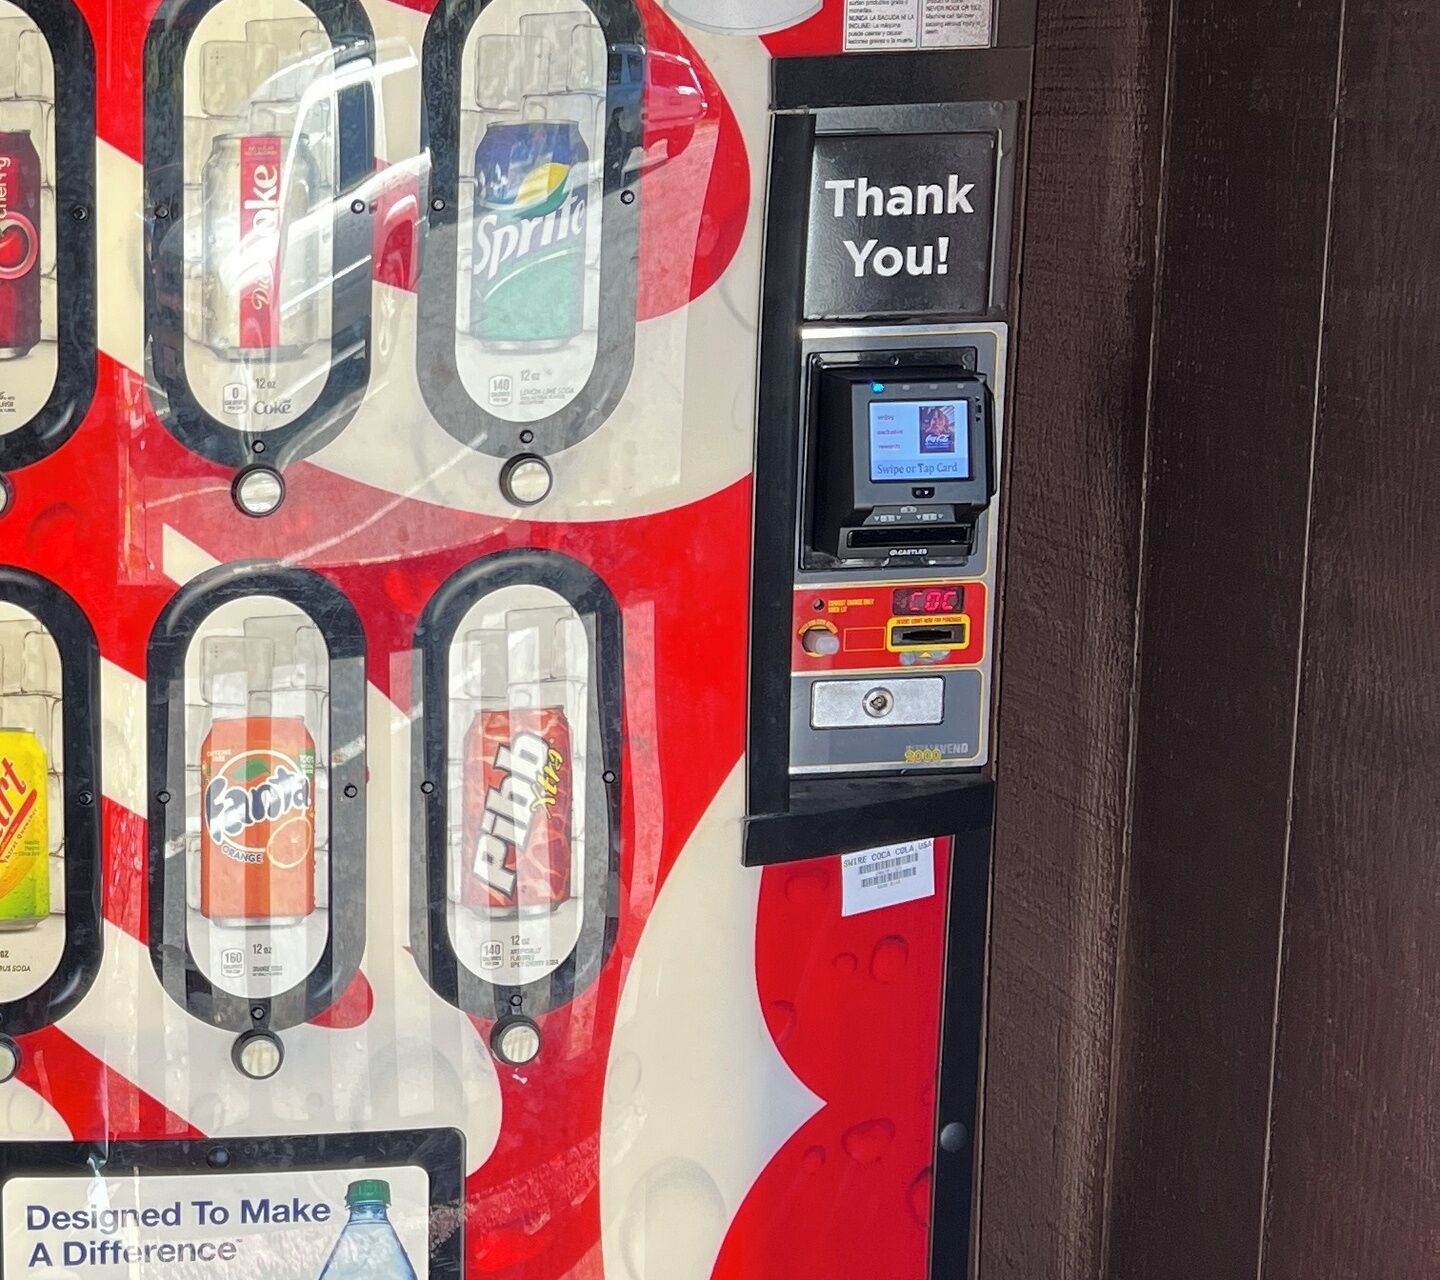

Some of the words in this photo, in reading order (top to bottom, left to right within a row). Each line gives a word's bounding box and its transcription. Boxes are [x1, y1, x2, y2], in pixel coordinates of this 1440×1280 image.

[825, 174, 976, 217] Thank
[474, 189, 587, 280] Sprite
[842, 237, 949, 277] You!
[521, 369, 530, 381] 12
[256, 378, 265, 389] 12
[494, 379, 510, 391] 140
[233, 387, 239, 399] 0
[254, 400, 291, 414] Coke
[877, 465, 904, 476] Swipe
[917, 463, 935, 475] Tap
[937, 462, 958, 472] Card
[222, 845, 262, 862] ORANGE
[844, 856, 867, 867] SWIRE
[872, 850, 891, 861] COCA
[511, 935, 520, 945] 12
[0, 950, 9, 958] oz
[253, 944, 262, 954] 12
[484, 944, 500, 955] 140
[225, 952, 242, 963] 160
[26, 1200, 181, 1235] Designed
[191, 1200, 229, 1227] To
[241, 1198, 331, 1225] Make
[28, 1242, 53, 1267] A
